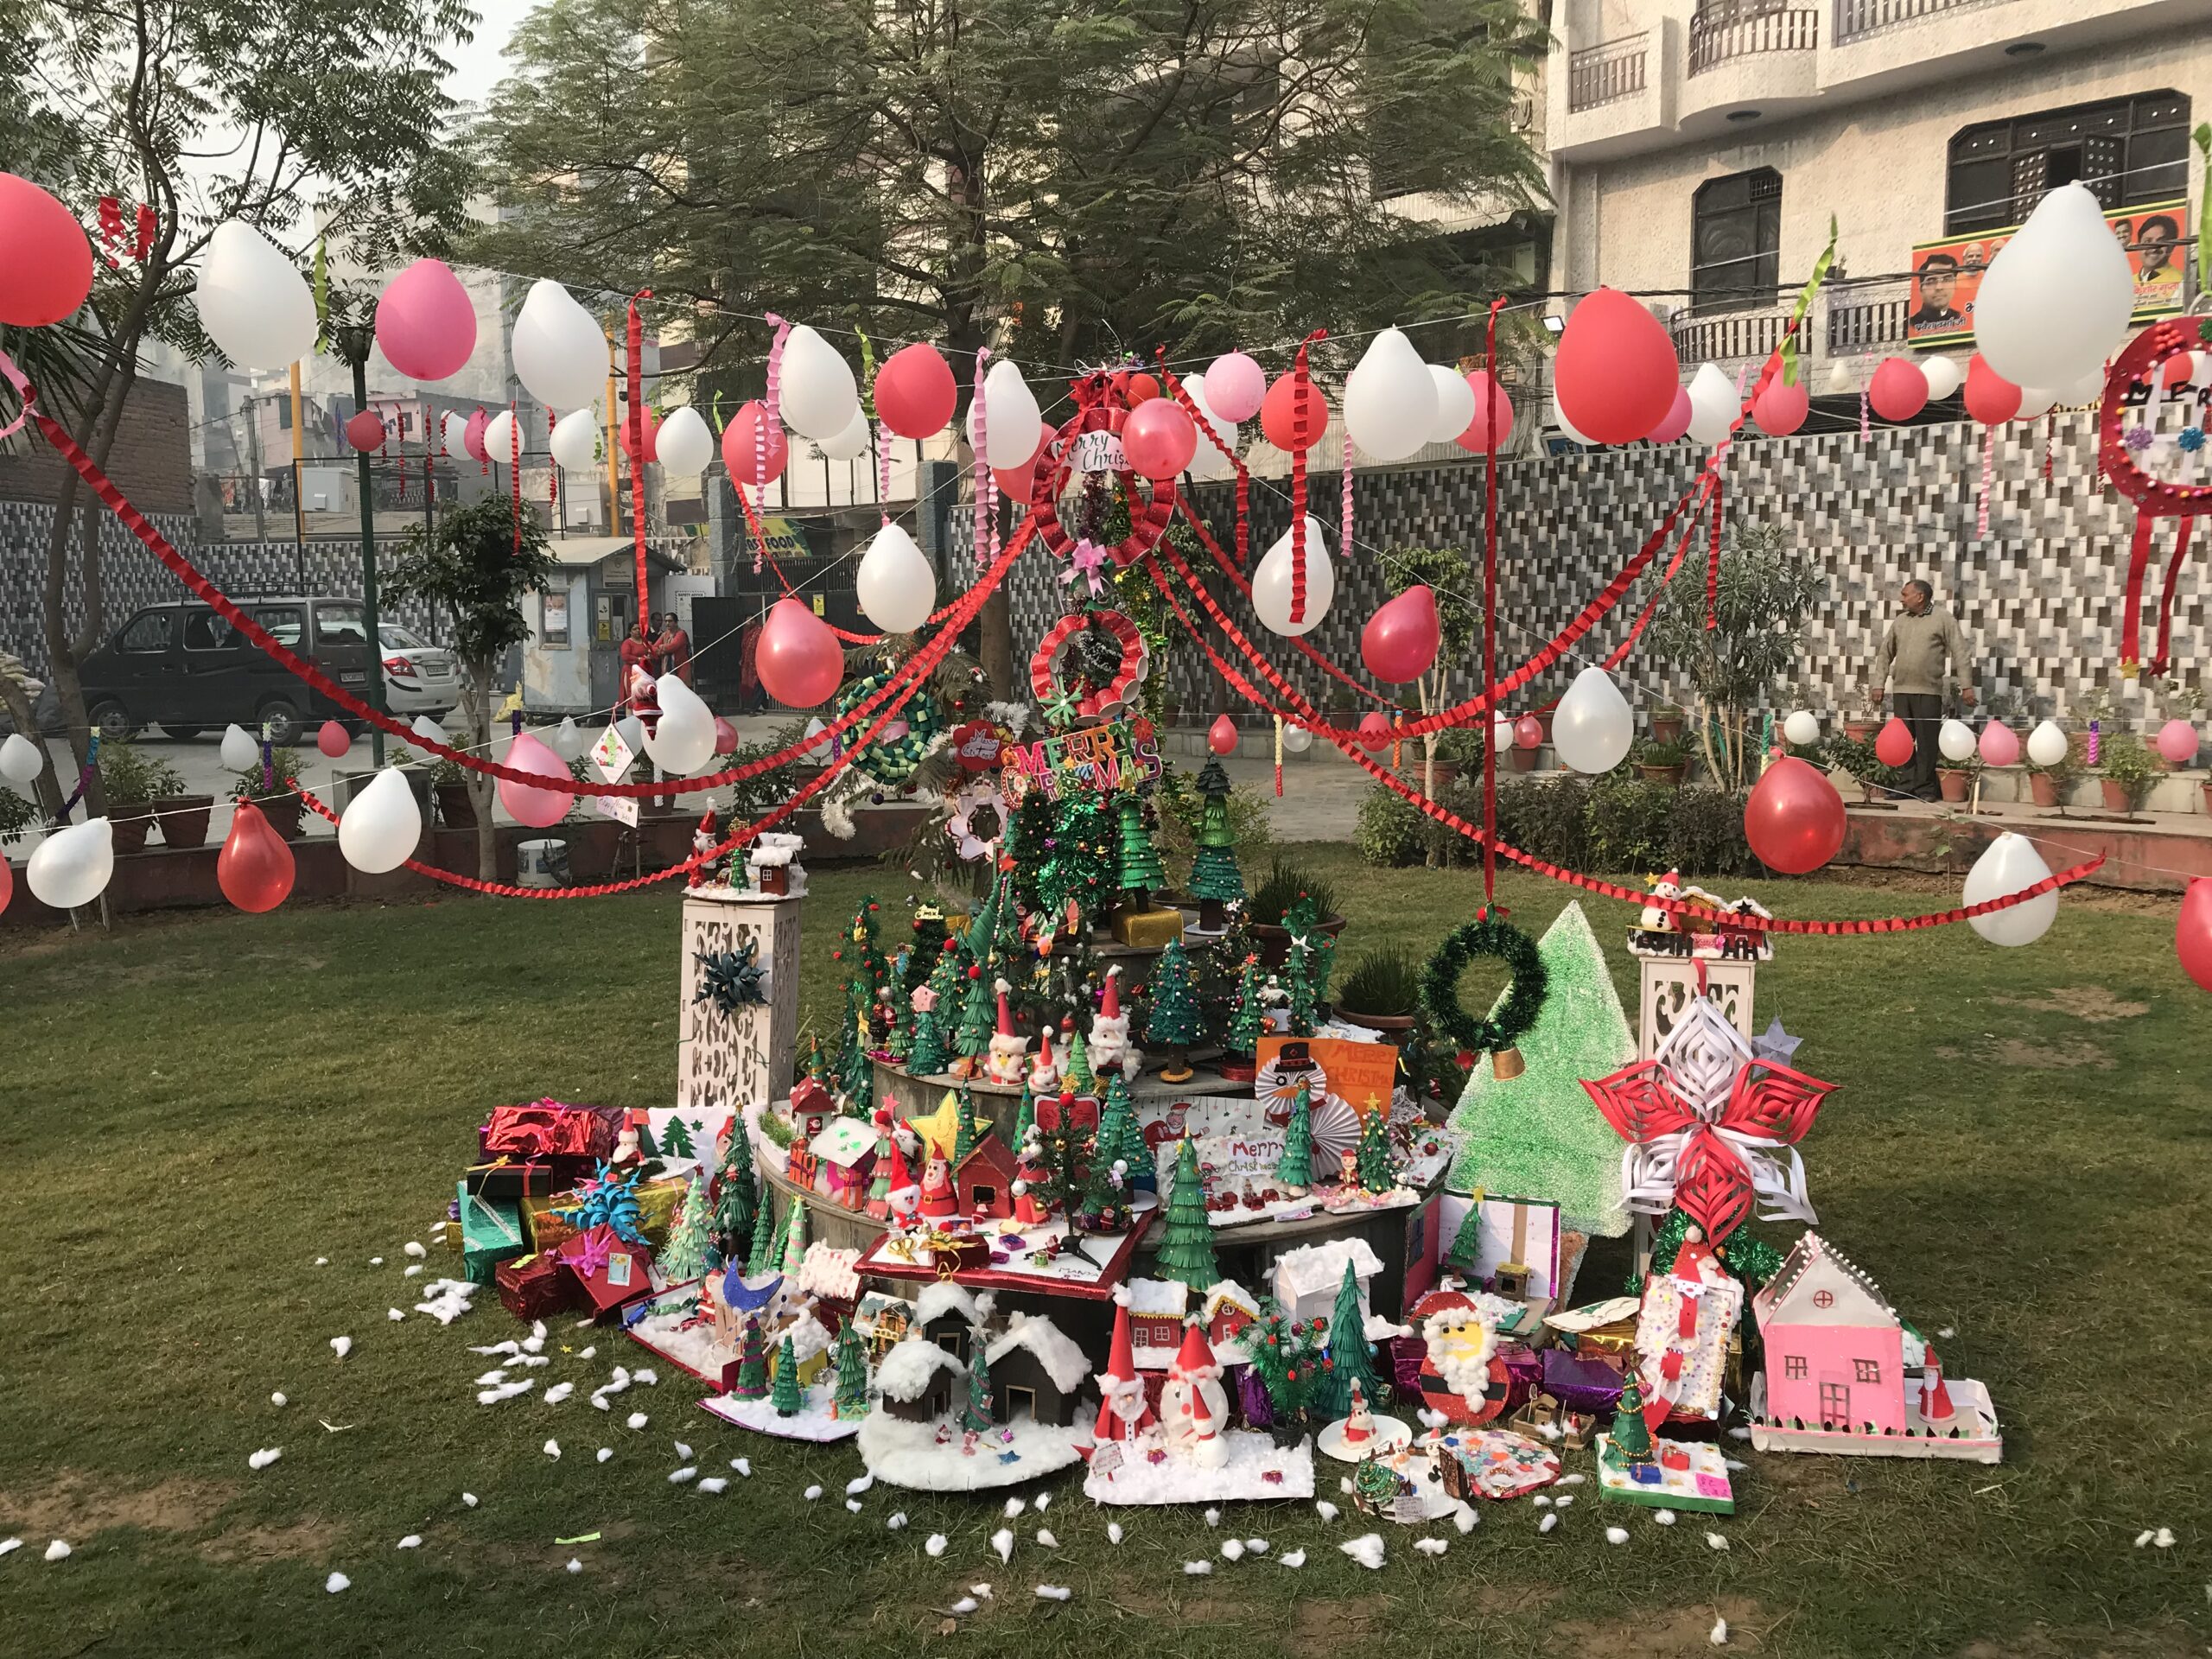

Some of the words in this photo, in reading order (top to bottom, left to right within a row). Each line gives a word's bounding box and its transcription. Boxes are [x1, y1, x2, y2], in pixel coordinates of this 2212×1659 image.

[2125, 380, 2212, 407] MER
[765, 536, 796, 550] FOOD
[1014, 721, 1140, 776] MERRY
[1331, 1044, 1396, 1062] MERRY
